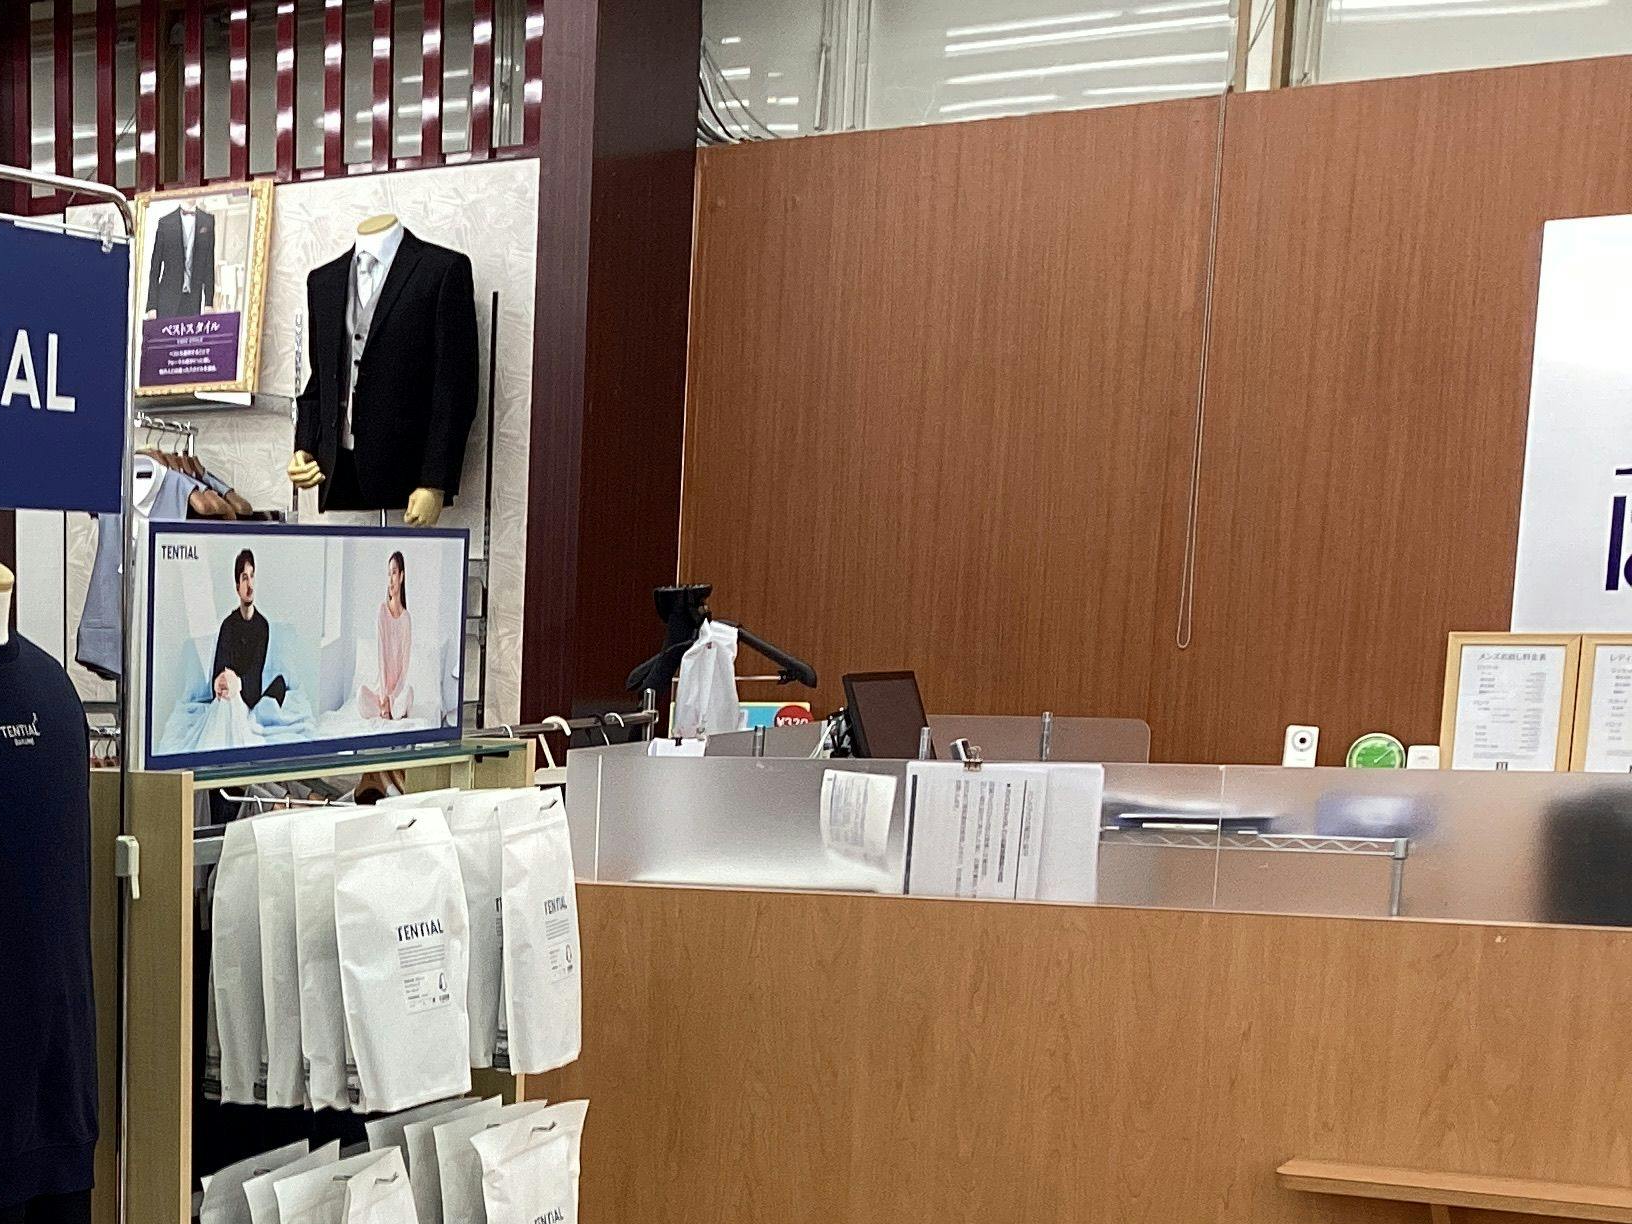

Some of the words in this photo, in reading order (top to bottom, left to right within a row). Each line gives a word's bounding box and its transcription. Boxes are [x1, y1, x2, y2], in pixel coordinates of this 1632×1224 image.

[161, 544, 200, 560] TENTIAL
[0, 722, 41, 739] TENTIAL
[397, 918, 444, 941] TENTIAL
